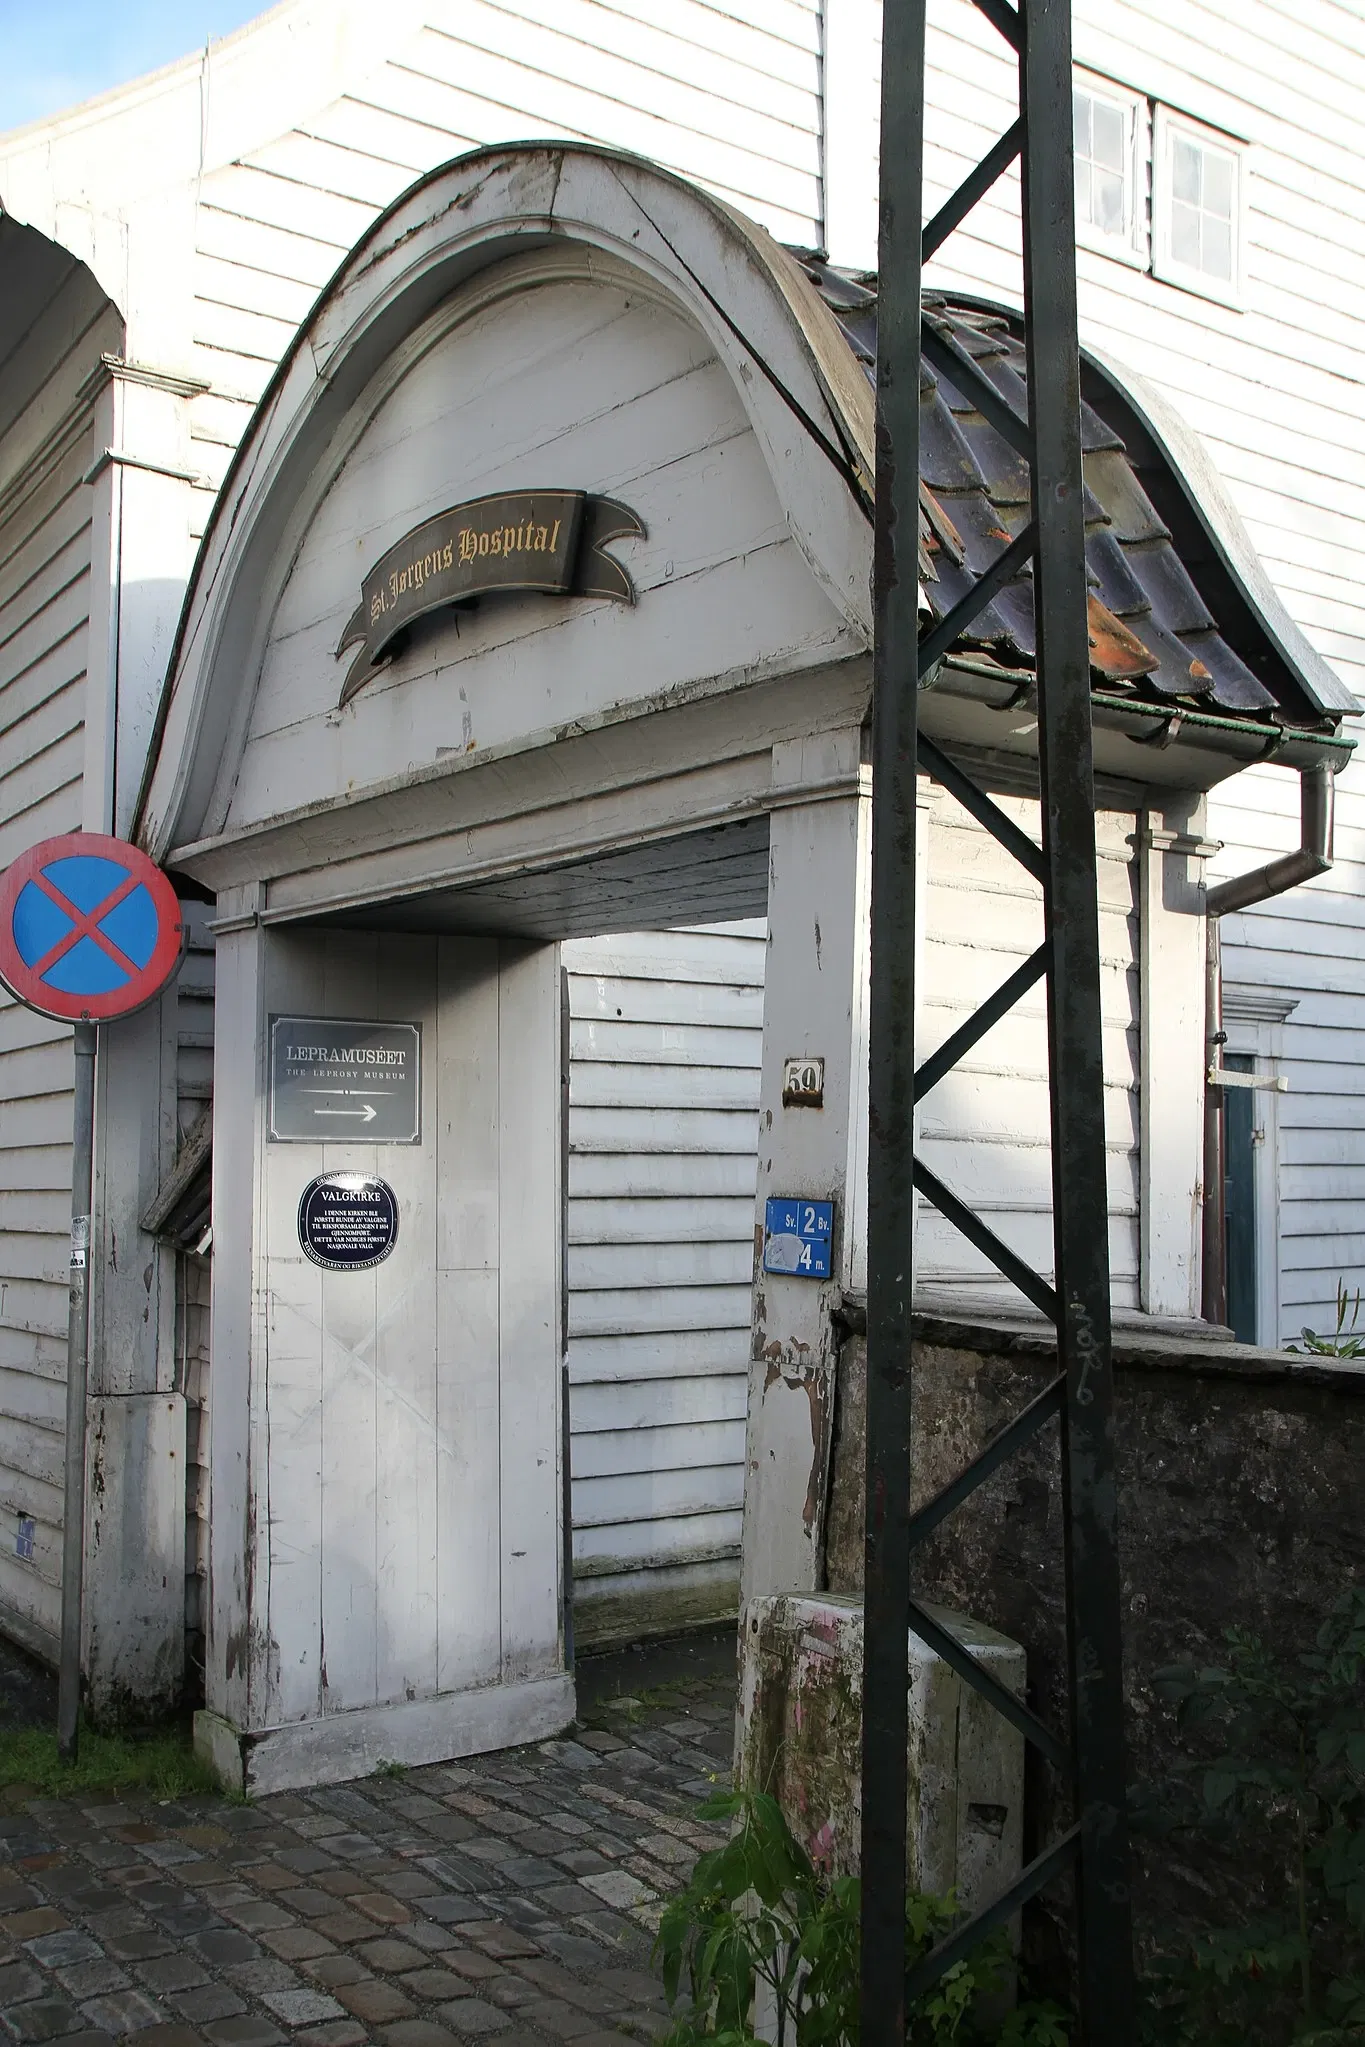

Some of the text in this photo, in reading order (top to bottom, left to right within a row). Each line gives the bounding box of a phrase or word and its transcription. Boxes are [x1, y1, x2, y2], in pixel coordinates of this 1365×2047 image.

[370, 518, 562, 626] St. Jørgens Hospital
[286, 1046, 406, 1065] LEPRAMUSÉET
[286, 1068, 406, 1080] THE LEPROSY MUSEUM
[789, 1067, 816, 1091] 59
[321, 1191, 381, 1202] VALGKIRKE
[785, 1207, 829, 1233] Sv. 2 Bv.
[800, 1244, 825, 1270] 4 m.
